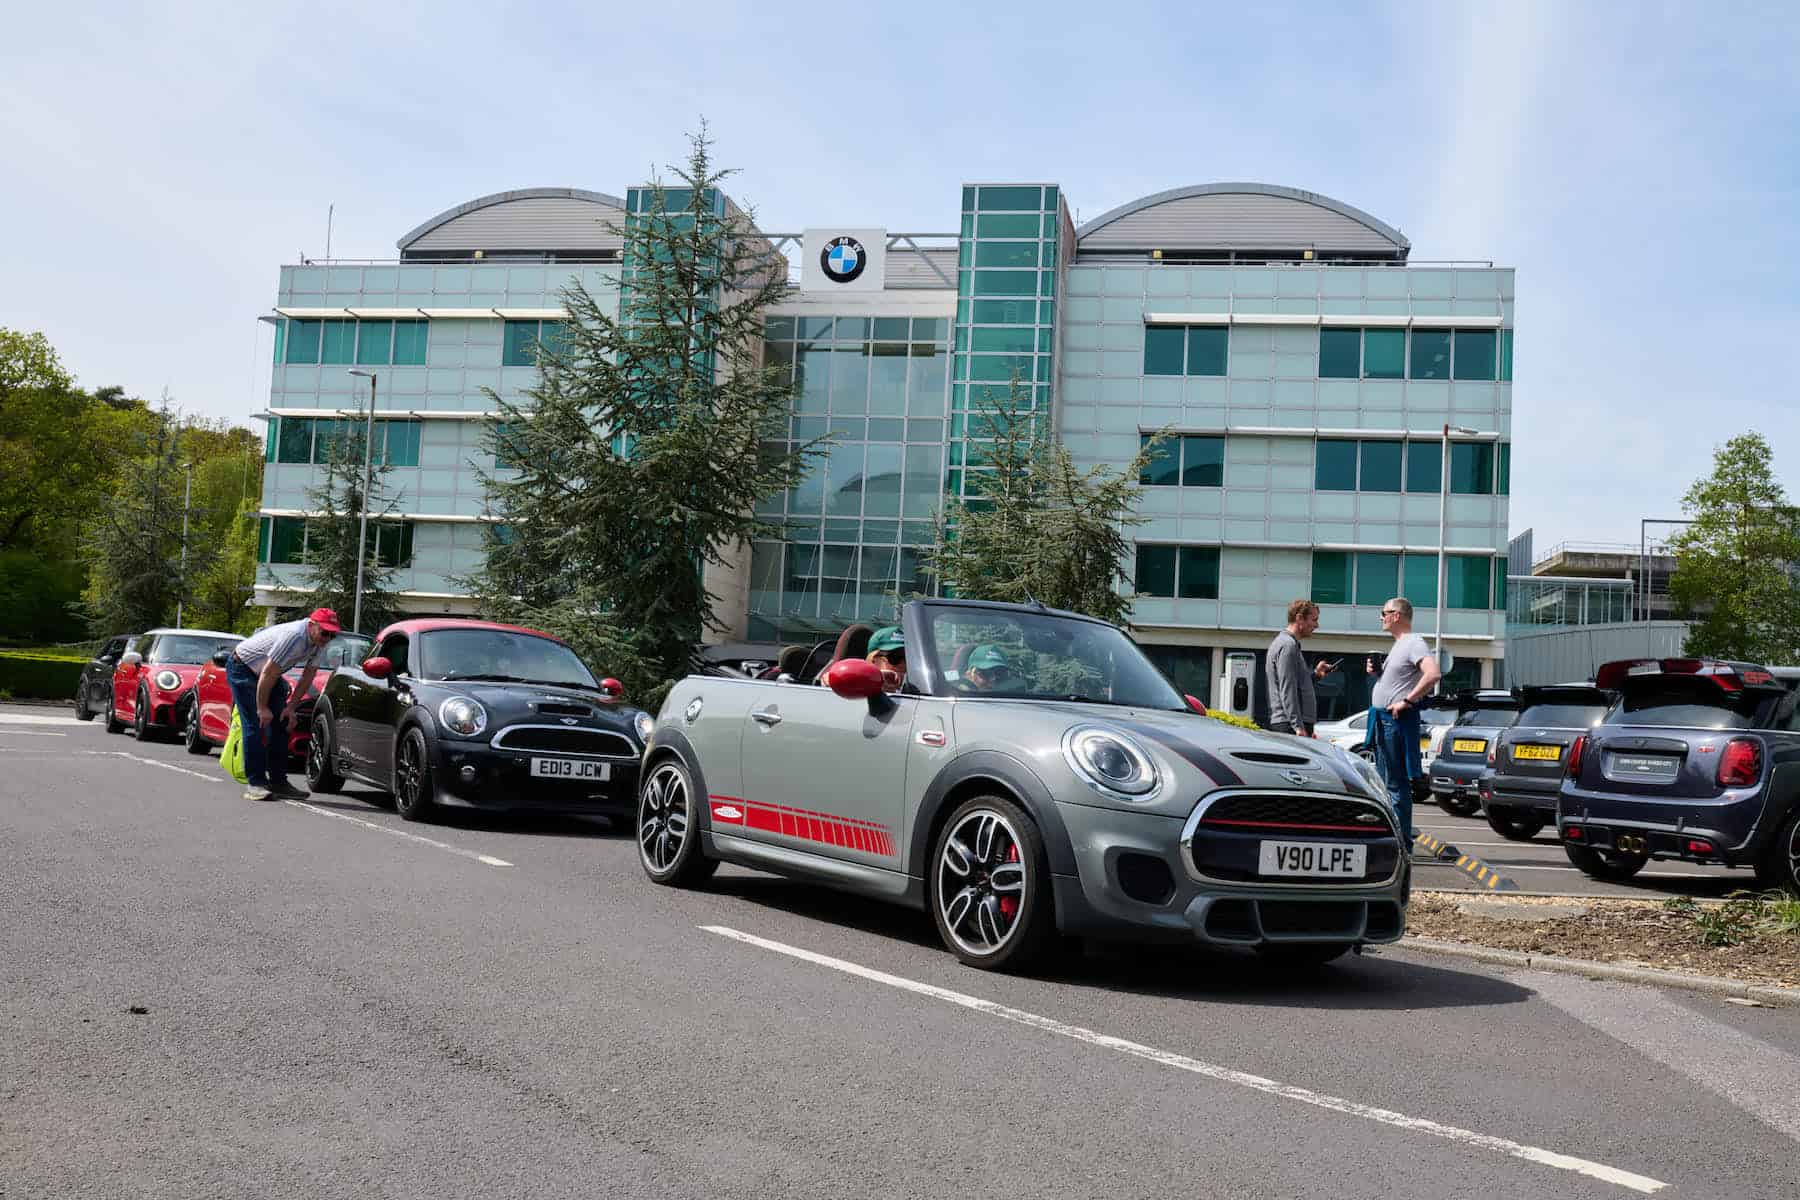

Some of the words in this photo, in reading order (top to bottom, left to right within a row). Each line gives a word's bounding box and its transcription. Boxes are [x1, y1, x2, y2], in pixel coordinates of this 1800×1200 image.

[825, 237, 864, 252] BMW
[540, 760, 572, 776] ED13
[575, 762, 602, 778] JCW
[1276, 845, 1314, 871] V90
[1318, 847, 1354, 872] LPE
